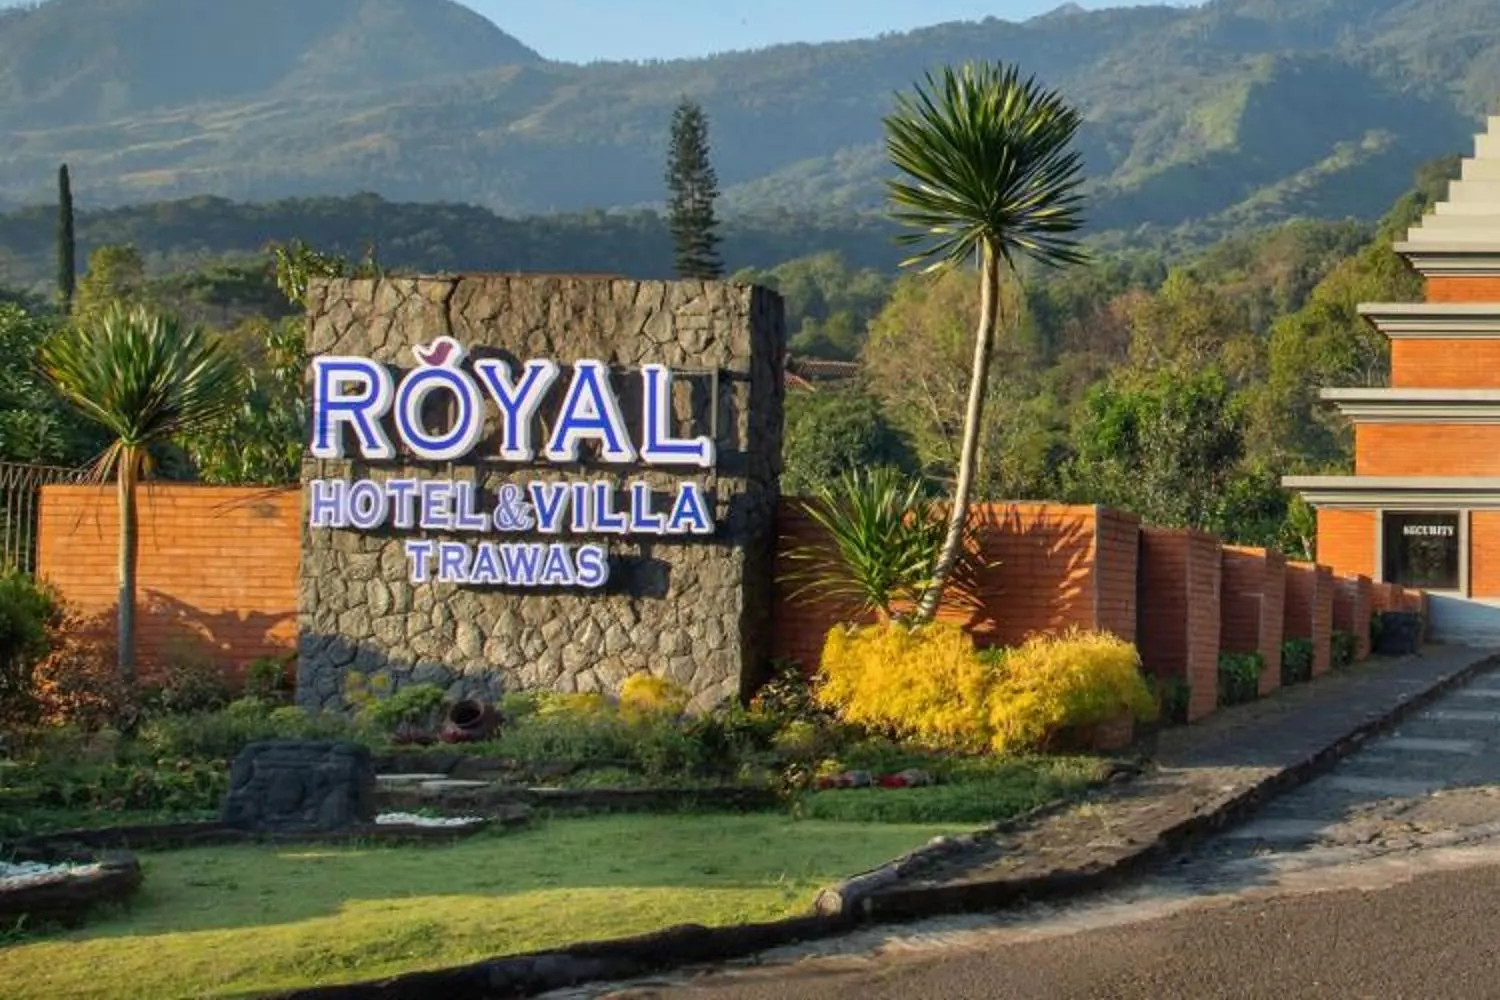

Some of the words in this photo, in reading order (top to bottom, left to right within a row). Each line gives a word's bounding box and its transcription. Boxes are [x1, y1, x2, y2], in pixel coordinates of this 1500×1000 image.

[312, 355, 716, 466] ROYAL
[1403, 525, 1454, 536] SECURITY
[405, 540, 610, 587] TRAWAS
